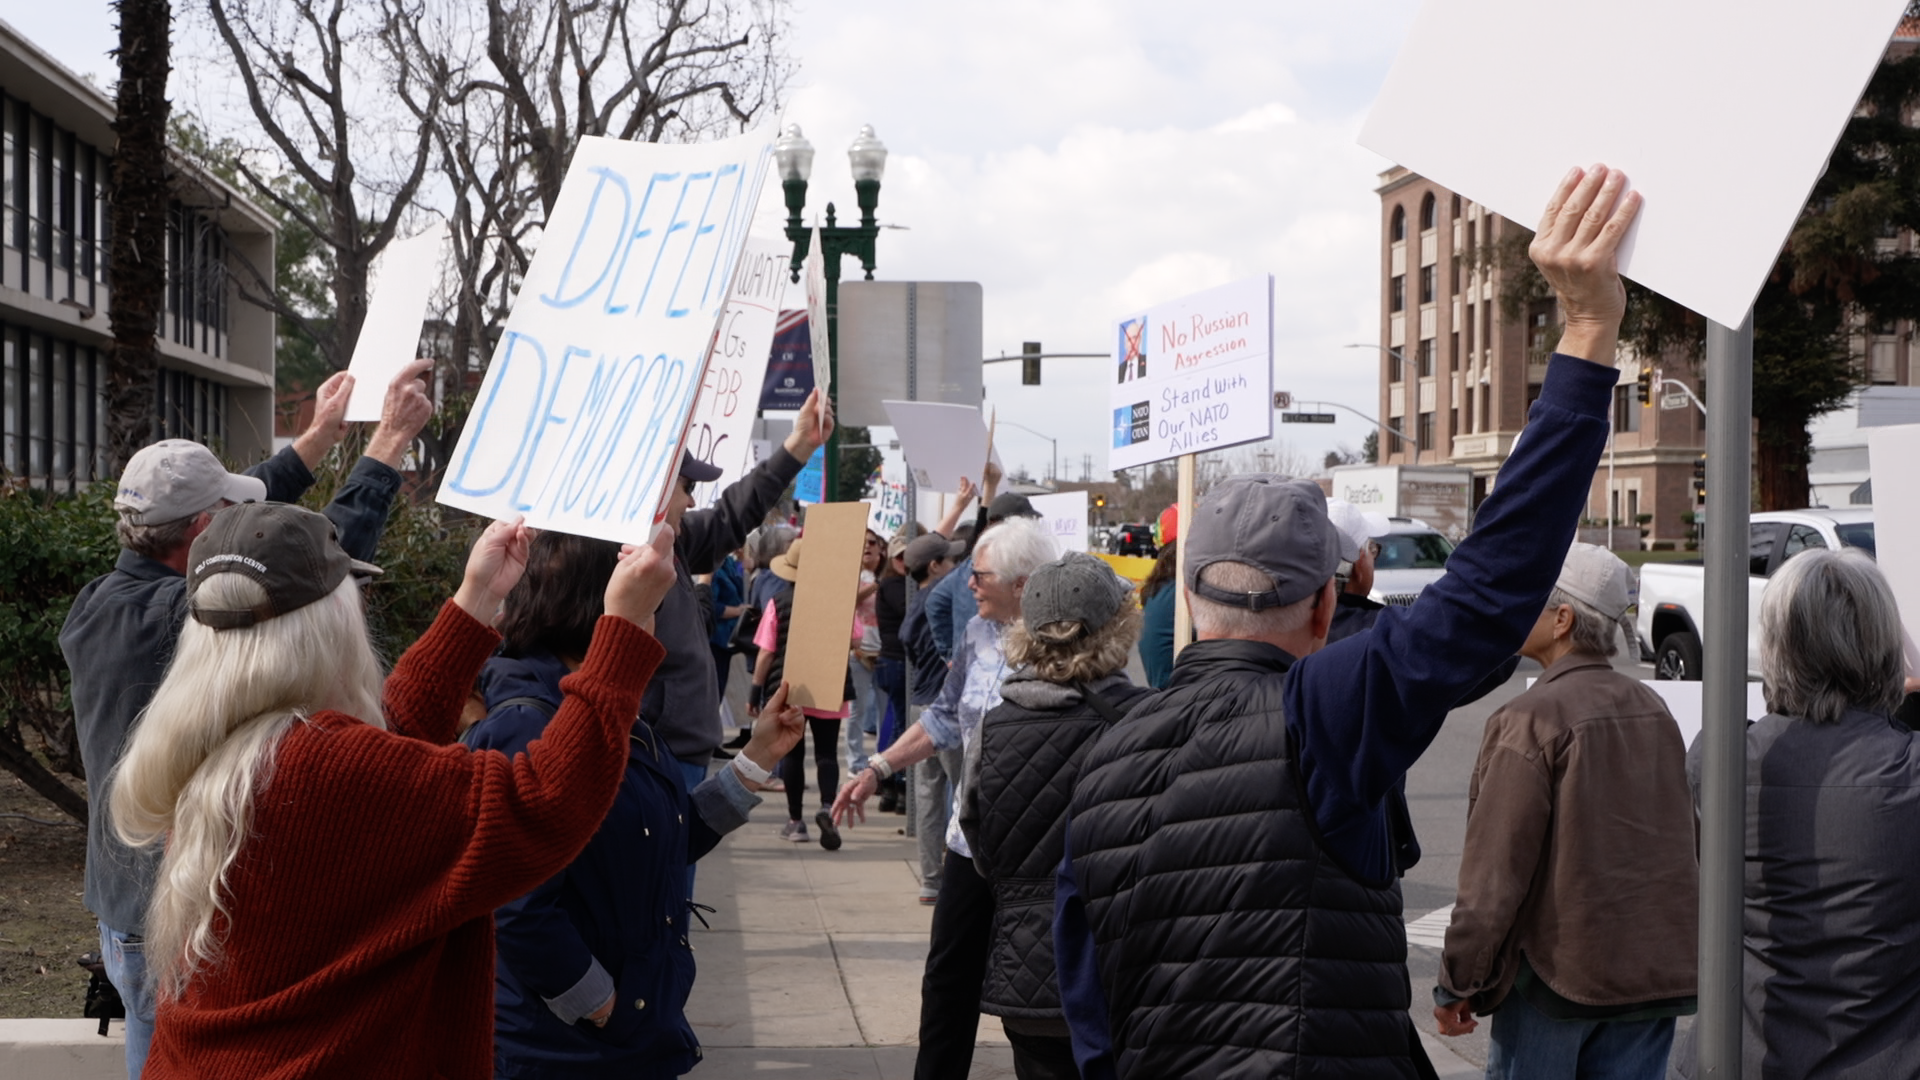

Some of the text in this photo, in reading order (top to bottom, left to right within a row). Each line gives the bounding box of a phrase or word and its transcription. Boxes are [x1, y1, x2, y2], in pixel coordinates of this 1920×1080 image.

[540, 144, 772, 318] DEFEN
[1162, 311, 1249, 353] No Russian
[1175, 338, 1246, 370] Aggression
[1132, 405, 1149, 419] NATO
[1161, 374, 1247, 413] Stand With
[1158, 402, 1229, 439] Our NATO
[692, 423, 728, 466] DC
[1170, 427, 1218, 453] Allies
[243, 557, 268, 573] CENTER
